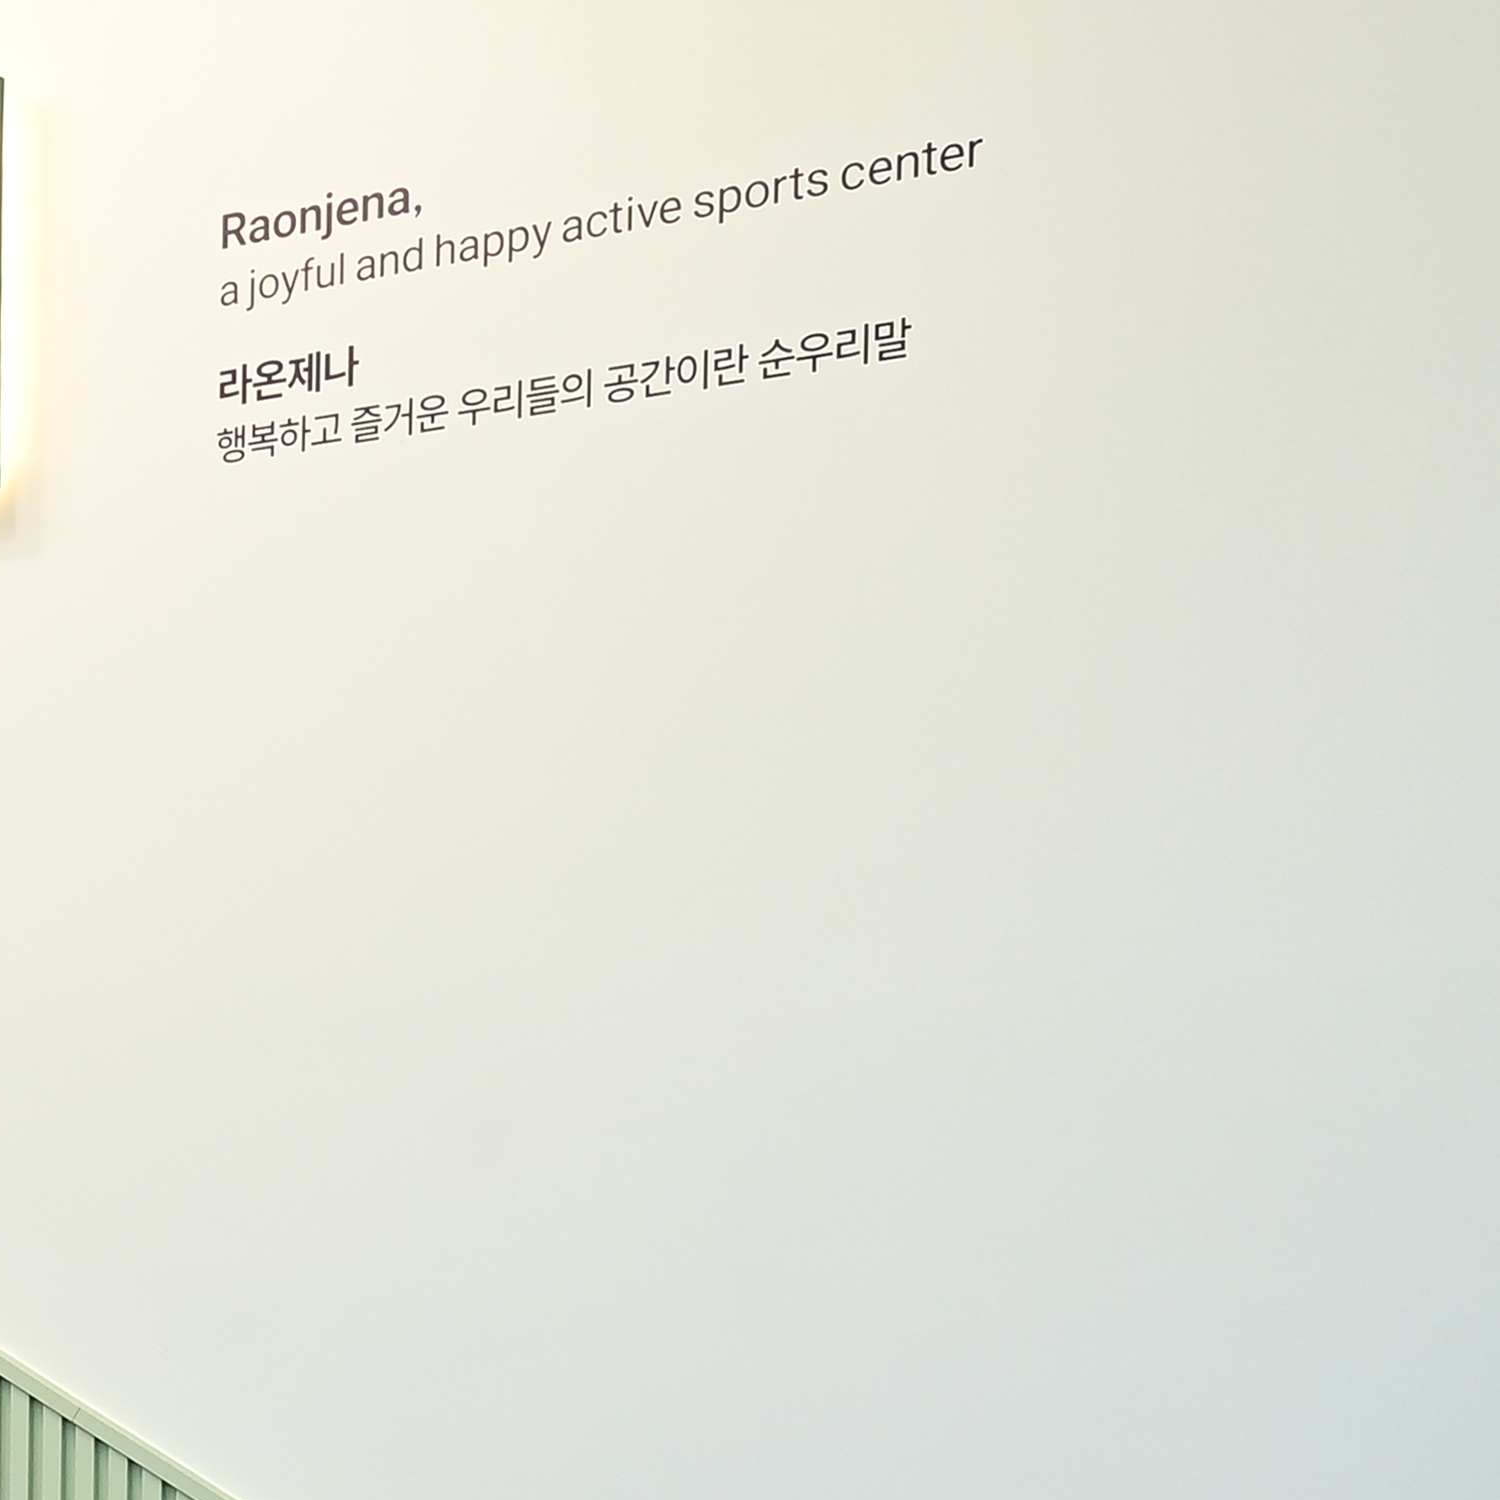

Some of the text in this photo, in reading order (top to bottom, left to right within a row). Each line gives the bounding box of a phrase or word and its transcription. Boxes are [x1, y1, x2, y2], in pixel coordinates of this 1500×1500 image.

[220, 135, 982, 311] a joyful and happy active sports center
[221, 185, 423, 249] Raonjena,
[216, 316, 912, 464] 행복하고 즐거운 우리들의 공간이란 순우리말
[218, 344, 359, 405] 라온제나
